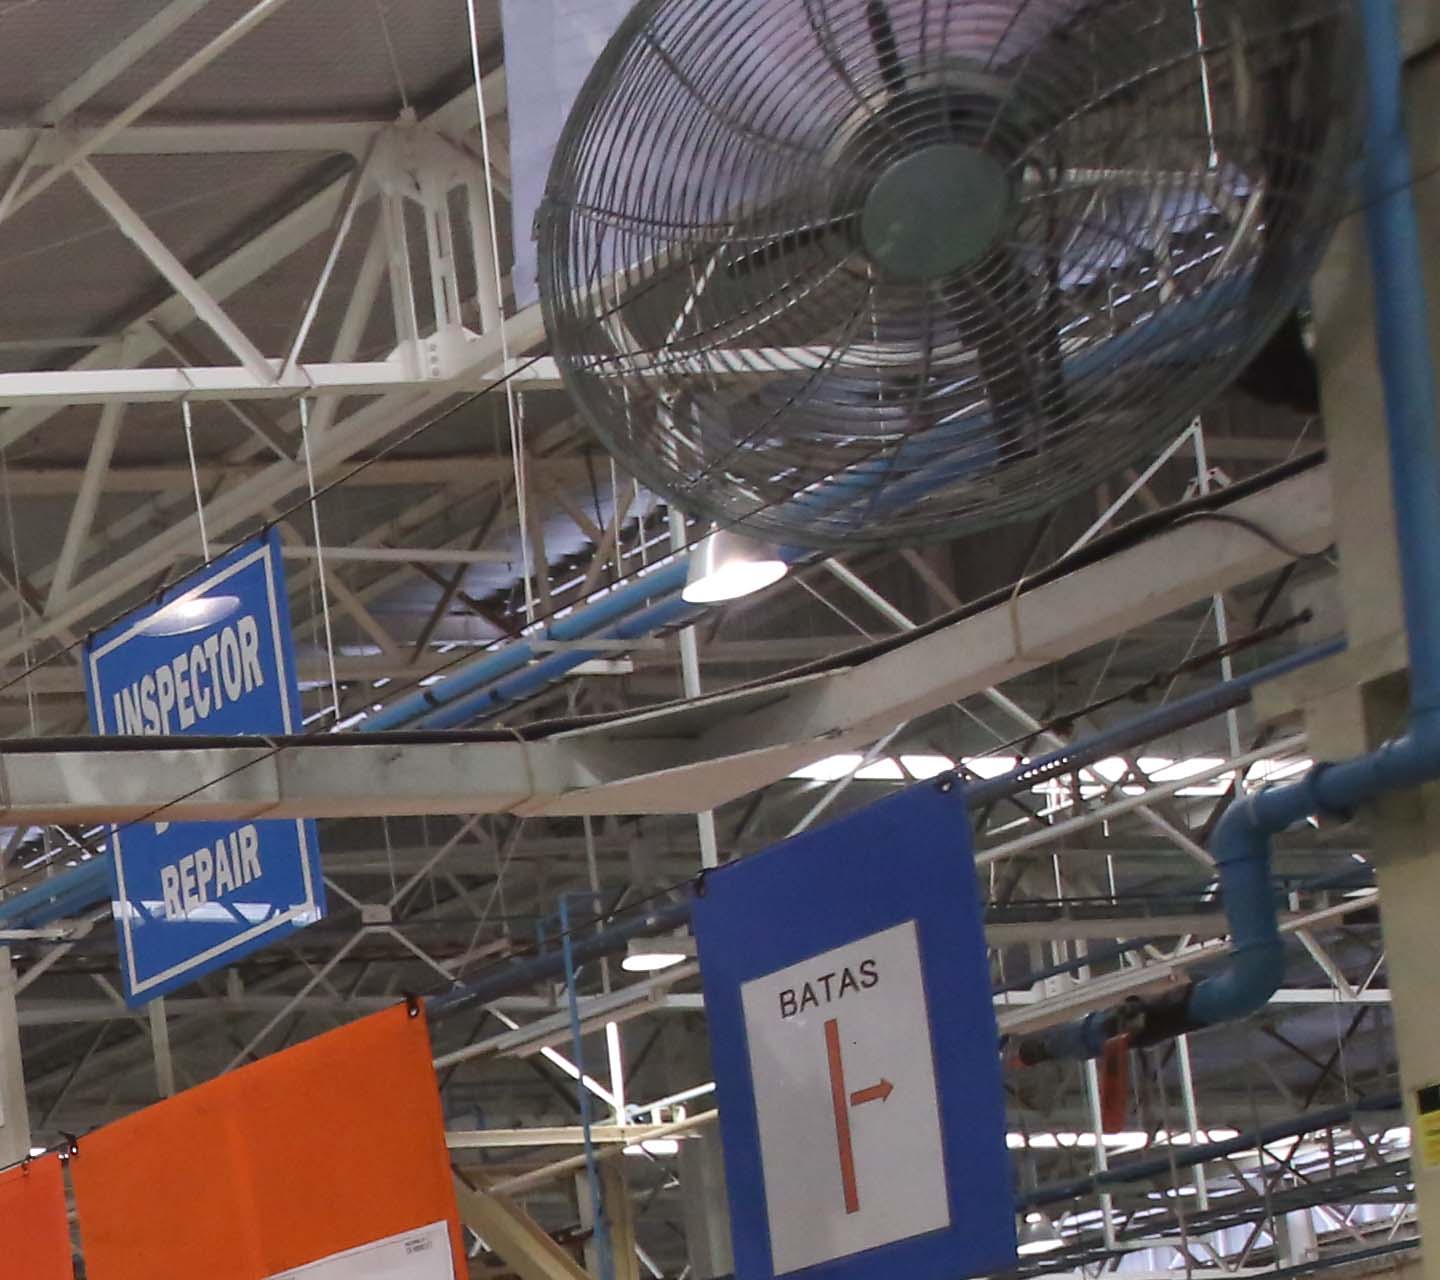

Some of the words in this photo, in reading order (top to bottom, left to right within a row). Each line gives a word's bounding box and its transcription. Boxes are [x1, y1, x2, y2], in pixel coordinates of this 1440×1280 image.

[114, 614, 264, 736] INSPECTOR
[160, 823, 263, 922] REPAIR
[779, 959, 879, 1019] BATAS
